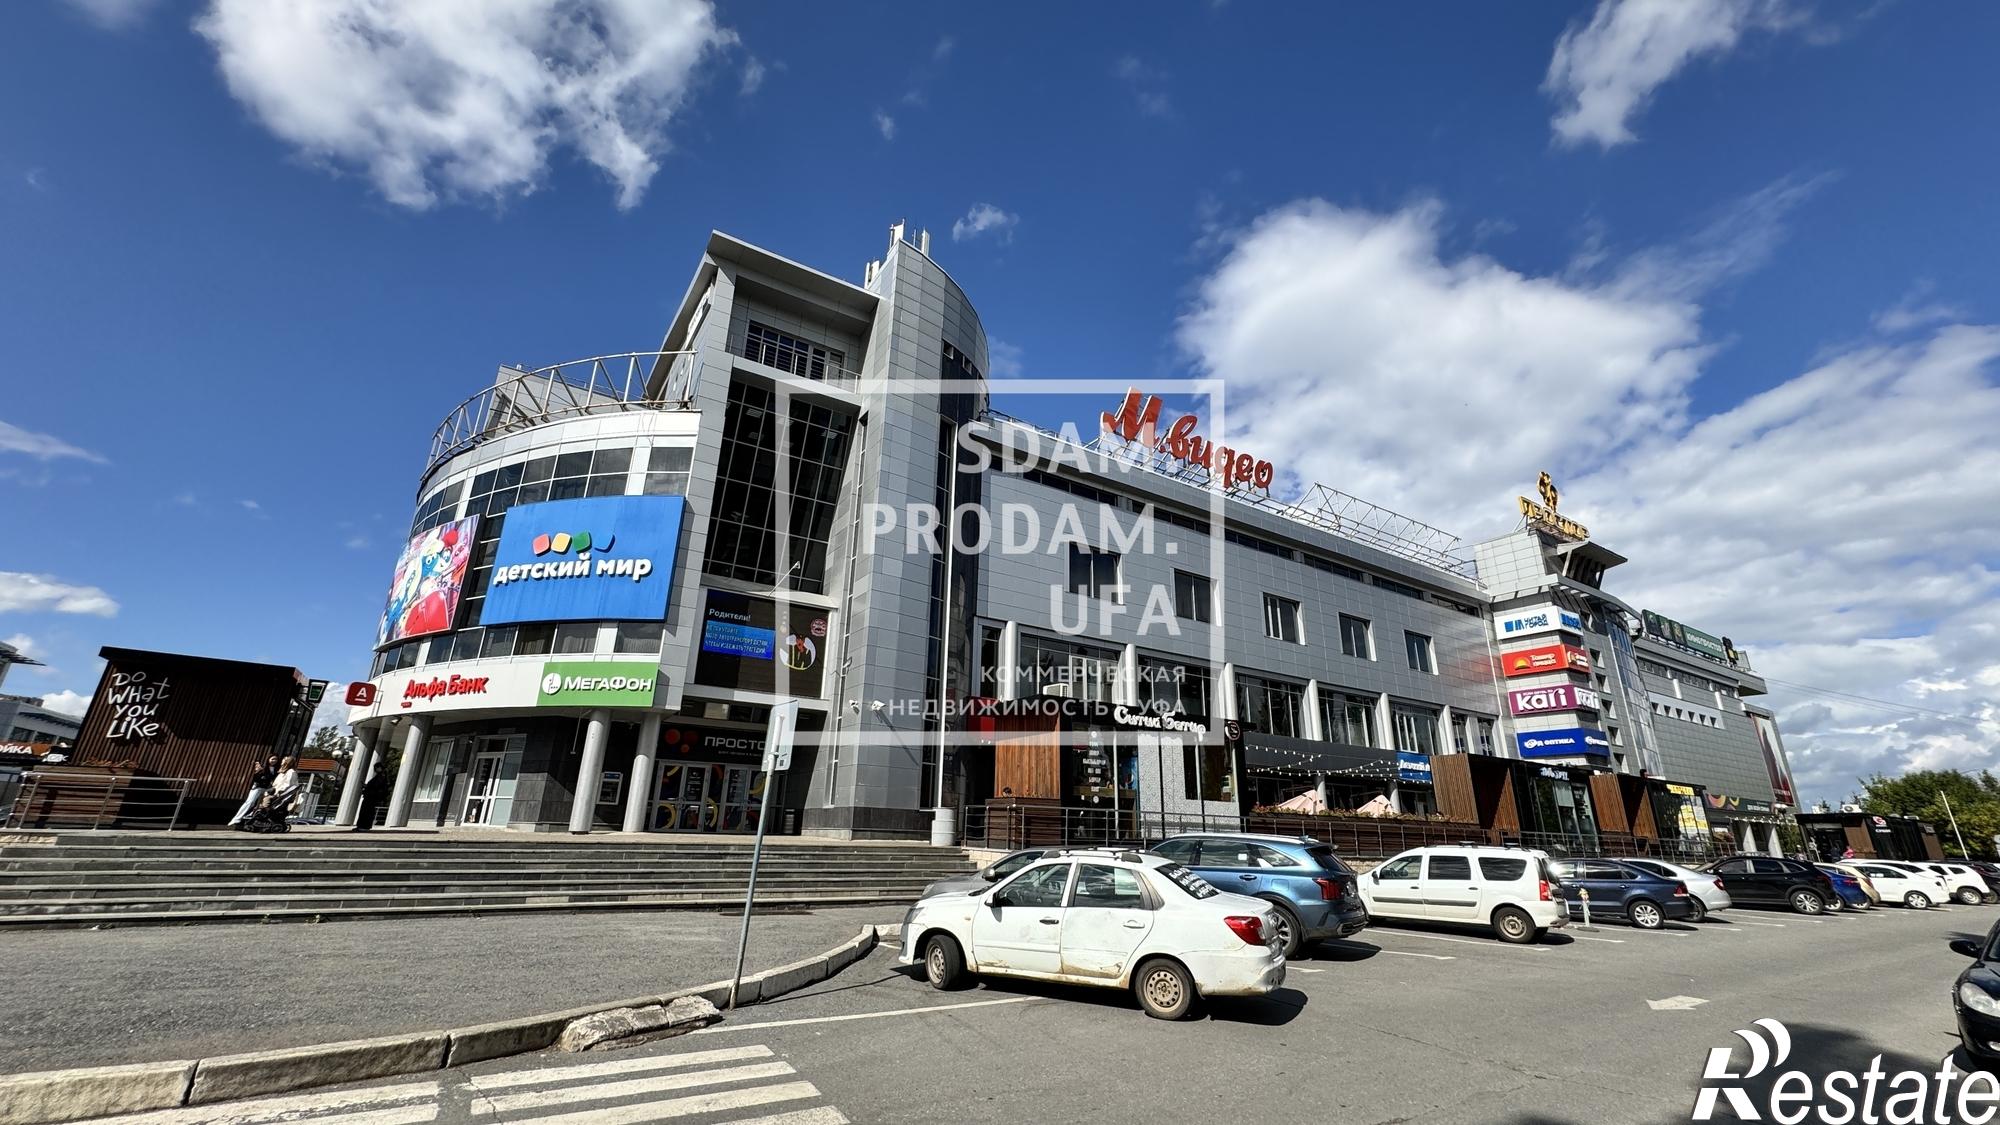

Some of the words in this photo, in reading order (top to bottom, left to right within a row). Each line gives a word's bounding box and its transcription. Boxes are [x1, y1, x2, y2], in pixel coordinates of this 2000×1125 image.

[493, 552, 591, 586] детский
[596, 558, 654, 582] мир
[708, 608, 752, 622] Родители!
[403, 677, 447, 702] Альфа
[447, 673, 490, 696] Банк
[1516, 688, 1568, 711] kari
[0, 743, 33, 755] ЙКА
